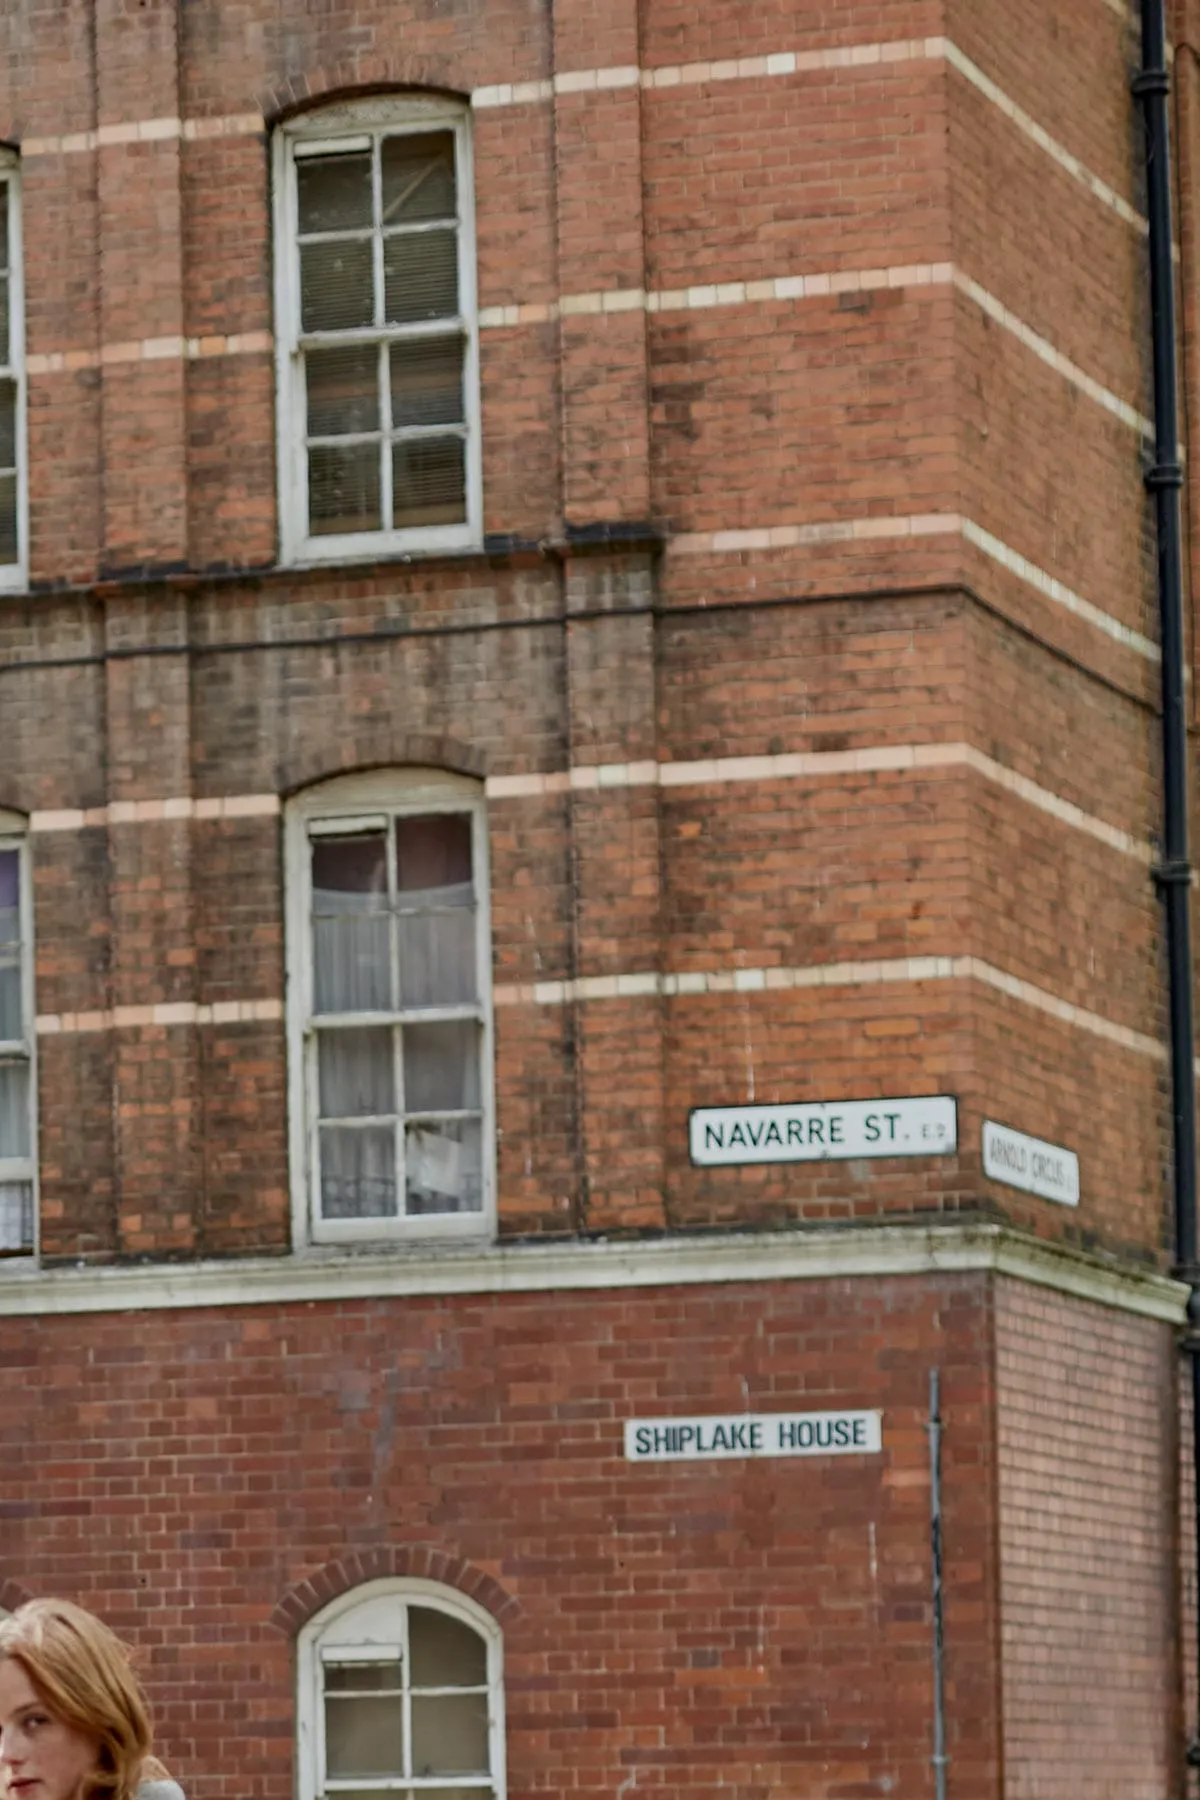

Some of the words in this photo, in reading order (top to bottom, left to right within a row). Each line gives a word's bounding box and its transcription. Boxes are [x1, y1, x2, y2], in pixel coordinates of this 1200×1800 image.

[704, 1116, 845, 1149] NAVARRE
[864, 1113, 910, 1141] ST.
[635, 1422, 763, 1454] SHIPLAKE
[779, 1418, 867, 1449] HOUSE
